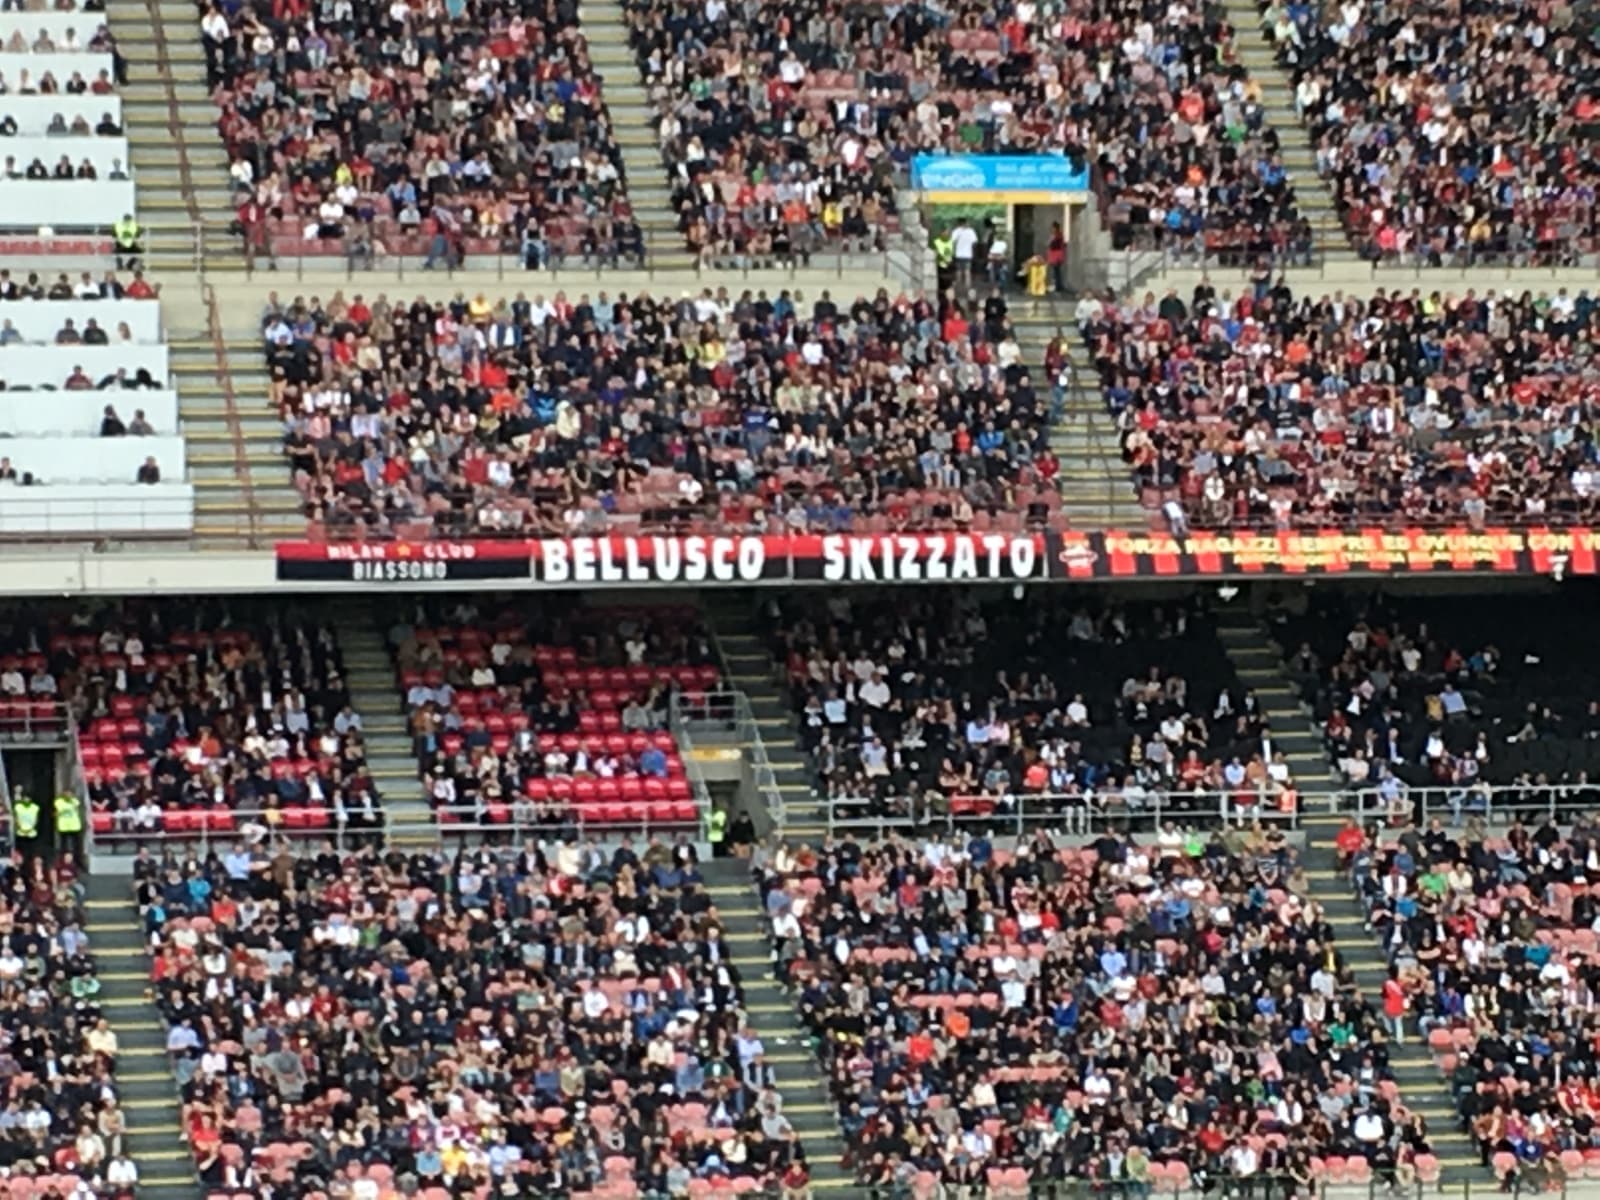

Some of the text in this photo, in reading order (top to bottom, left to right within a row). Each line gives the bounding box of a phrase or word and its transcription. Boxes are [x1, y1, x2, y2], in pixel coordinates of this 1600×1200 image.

[327, 543, 385, 559] MILAN
[1104, 536, 1181, 555] FORZA
[1184, 536, 1281, 554] RAGAZZI
[1286, 535, 1377, 552] SEMPRE
[1415, 534, 1525, 552] OVUNQUE
[1527, 534, 1574, 552] CON
[539, 536, 766, 582] BELLUSCO
[822, 535, 1036, 581] SKIZZATO
[353, 561, 447, 580] BIASSONO
